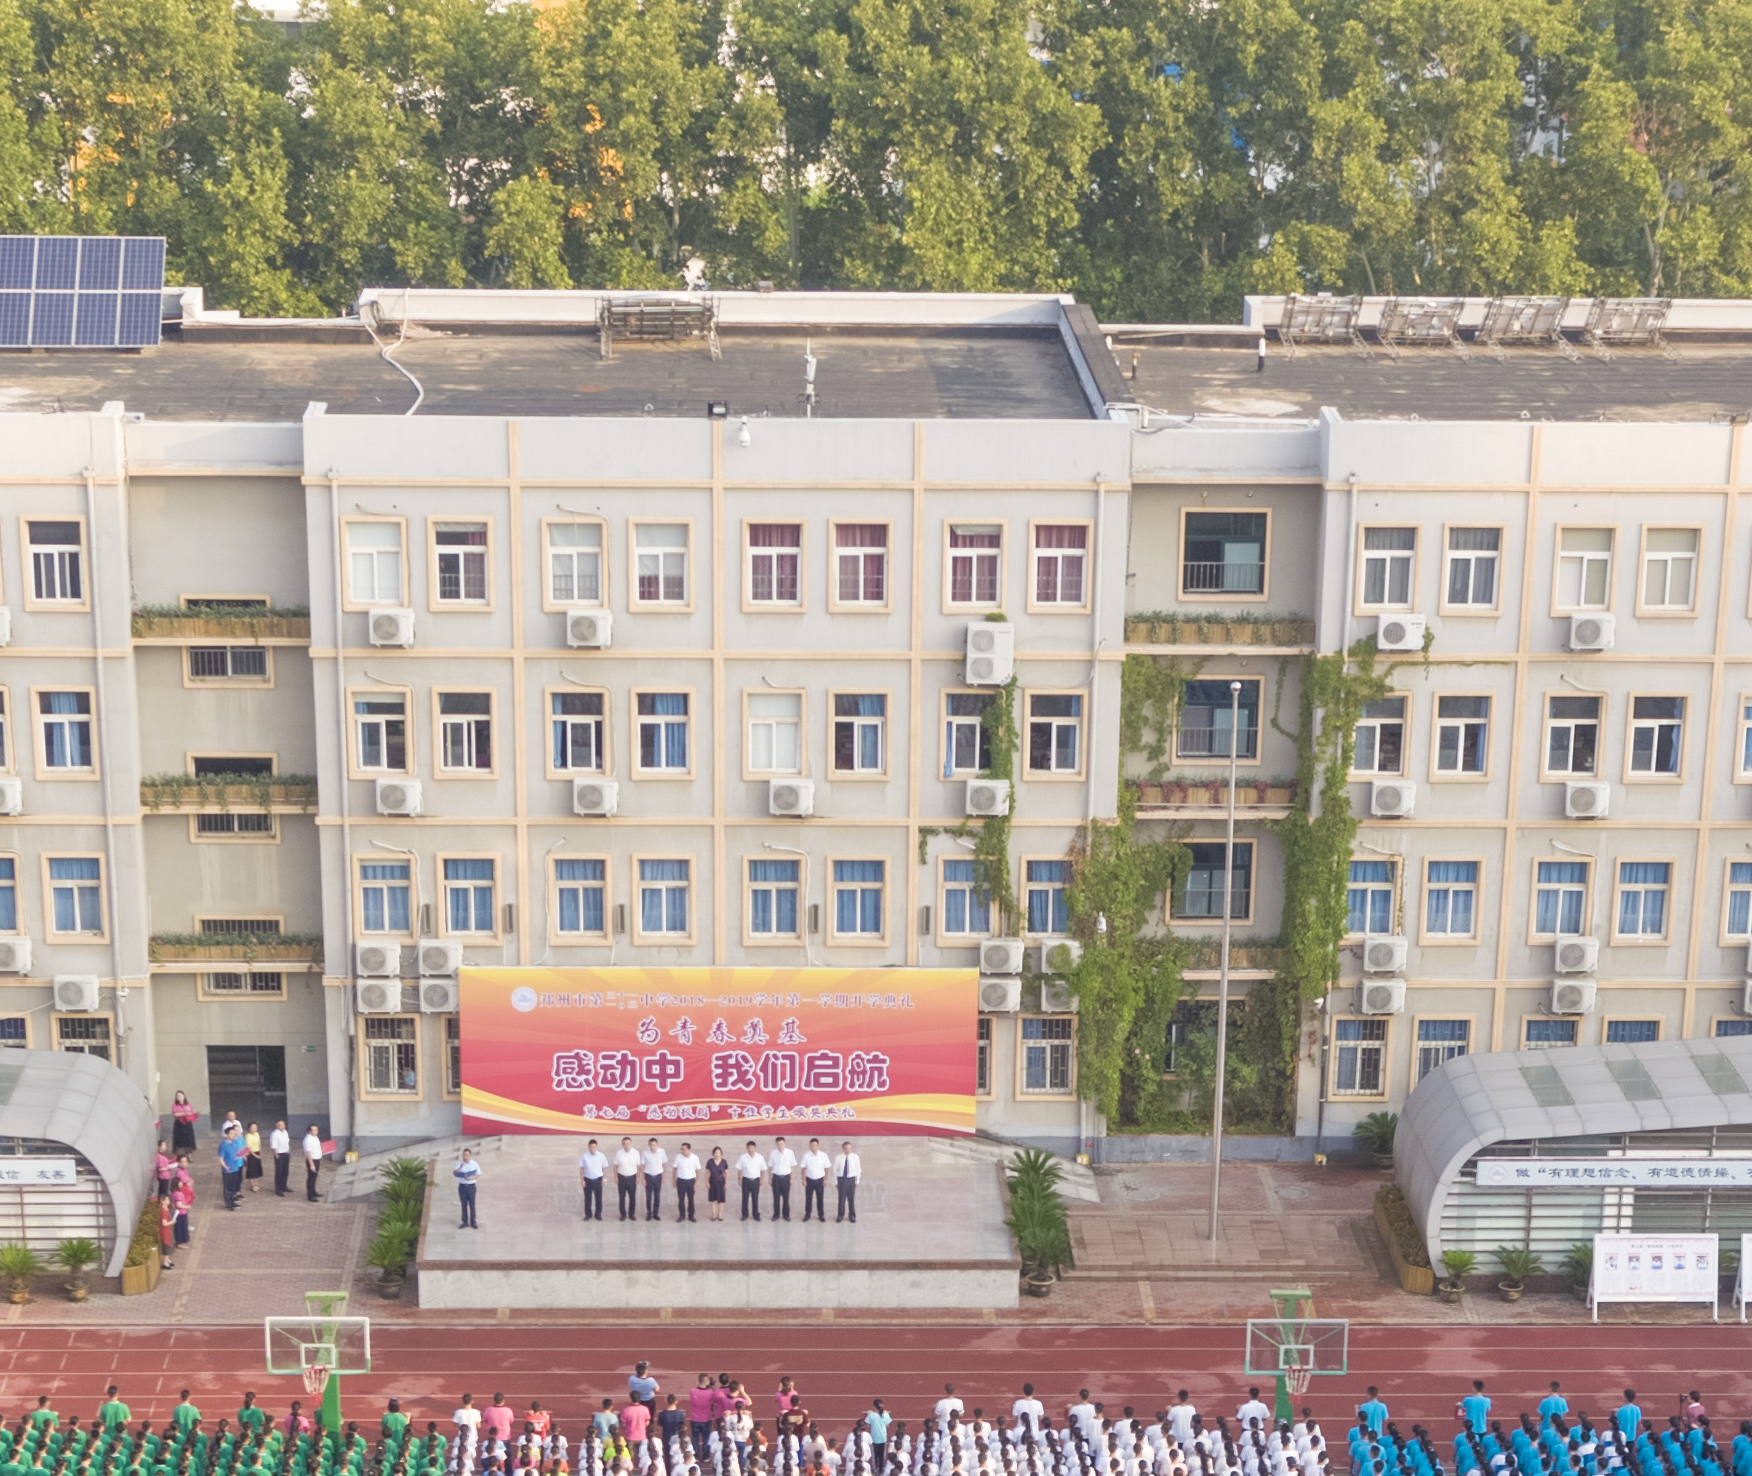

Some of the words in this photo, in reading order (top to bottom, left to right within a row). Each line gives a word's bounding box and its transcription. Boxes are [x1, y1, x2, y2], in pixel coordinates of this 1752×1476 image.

[551, 1050, 684, 1092] 感动中
[711, 1050, 890, 1092] 我们启航
[36, 1169, 66, 1180] 友善
